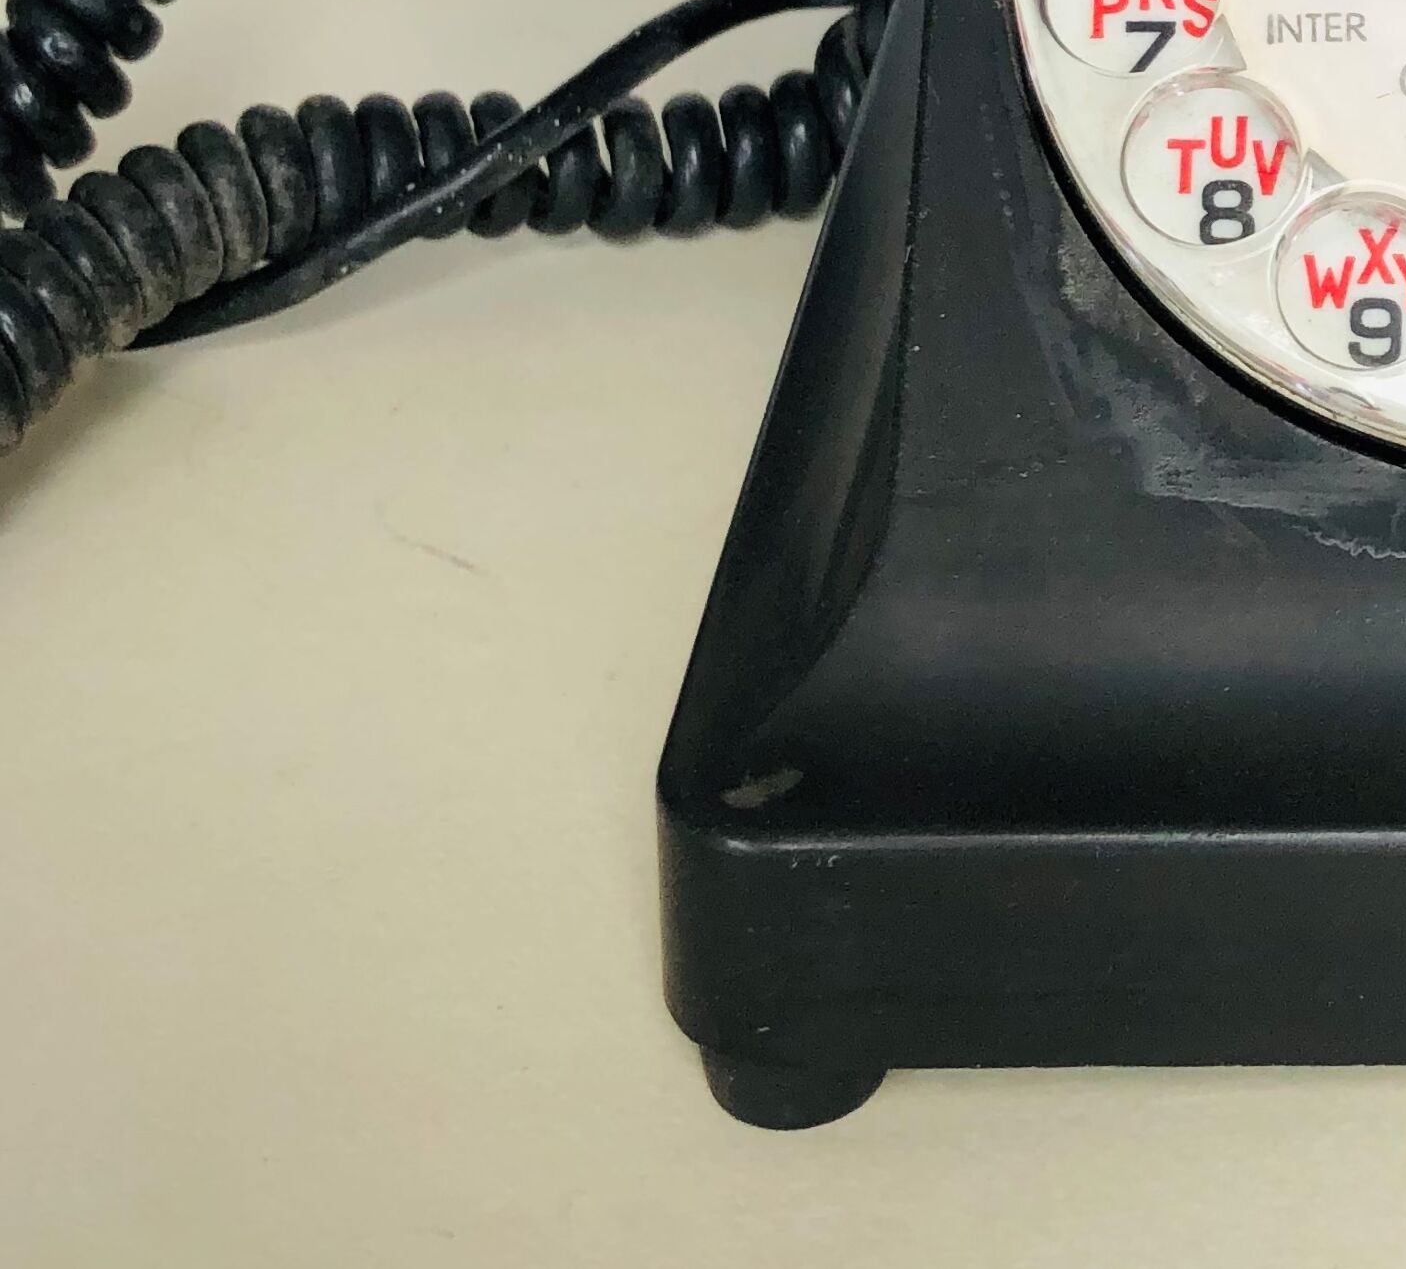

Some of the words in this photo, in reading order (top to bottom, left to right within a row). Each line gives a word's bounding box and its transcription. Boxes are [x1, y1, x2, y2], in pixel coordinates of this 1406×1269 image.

[1125, 21, 1176, 74] 7
[1266, 13, 1367, 45] INTER
[1167, 116, 1292, 196] TUV
[1199, 179, 1256, 245] 8
[1347, 298, 1403, 367] 9
